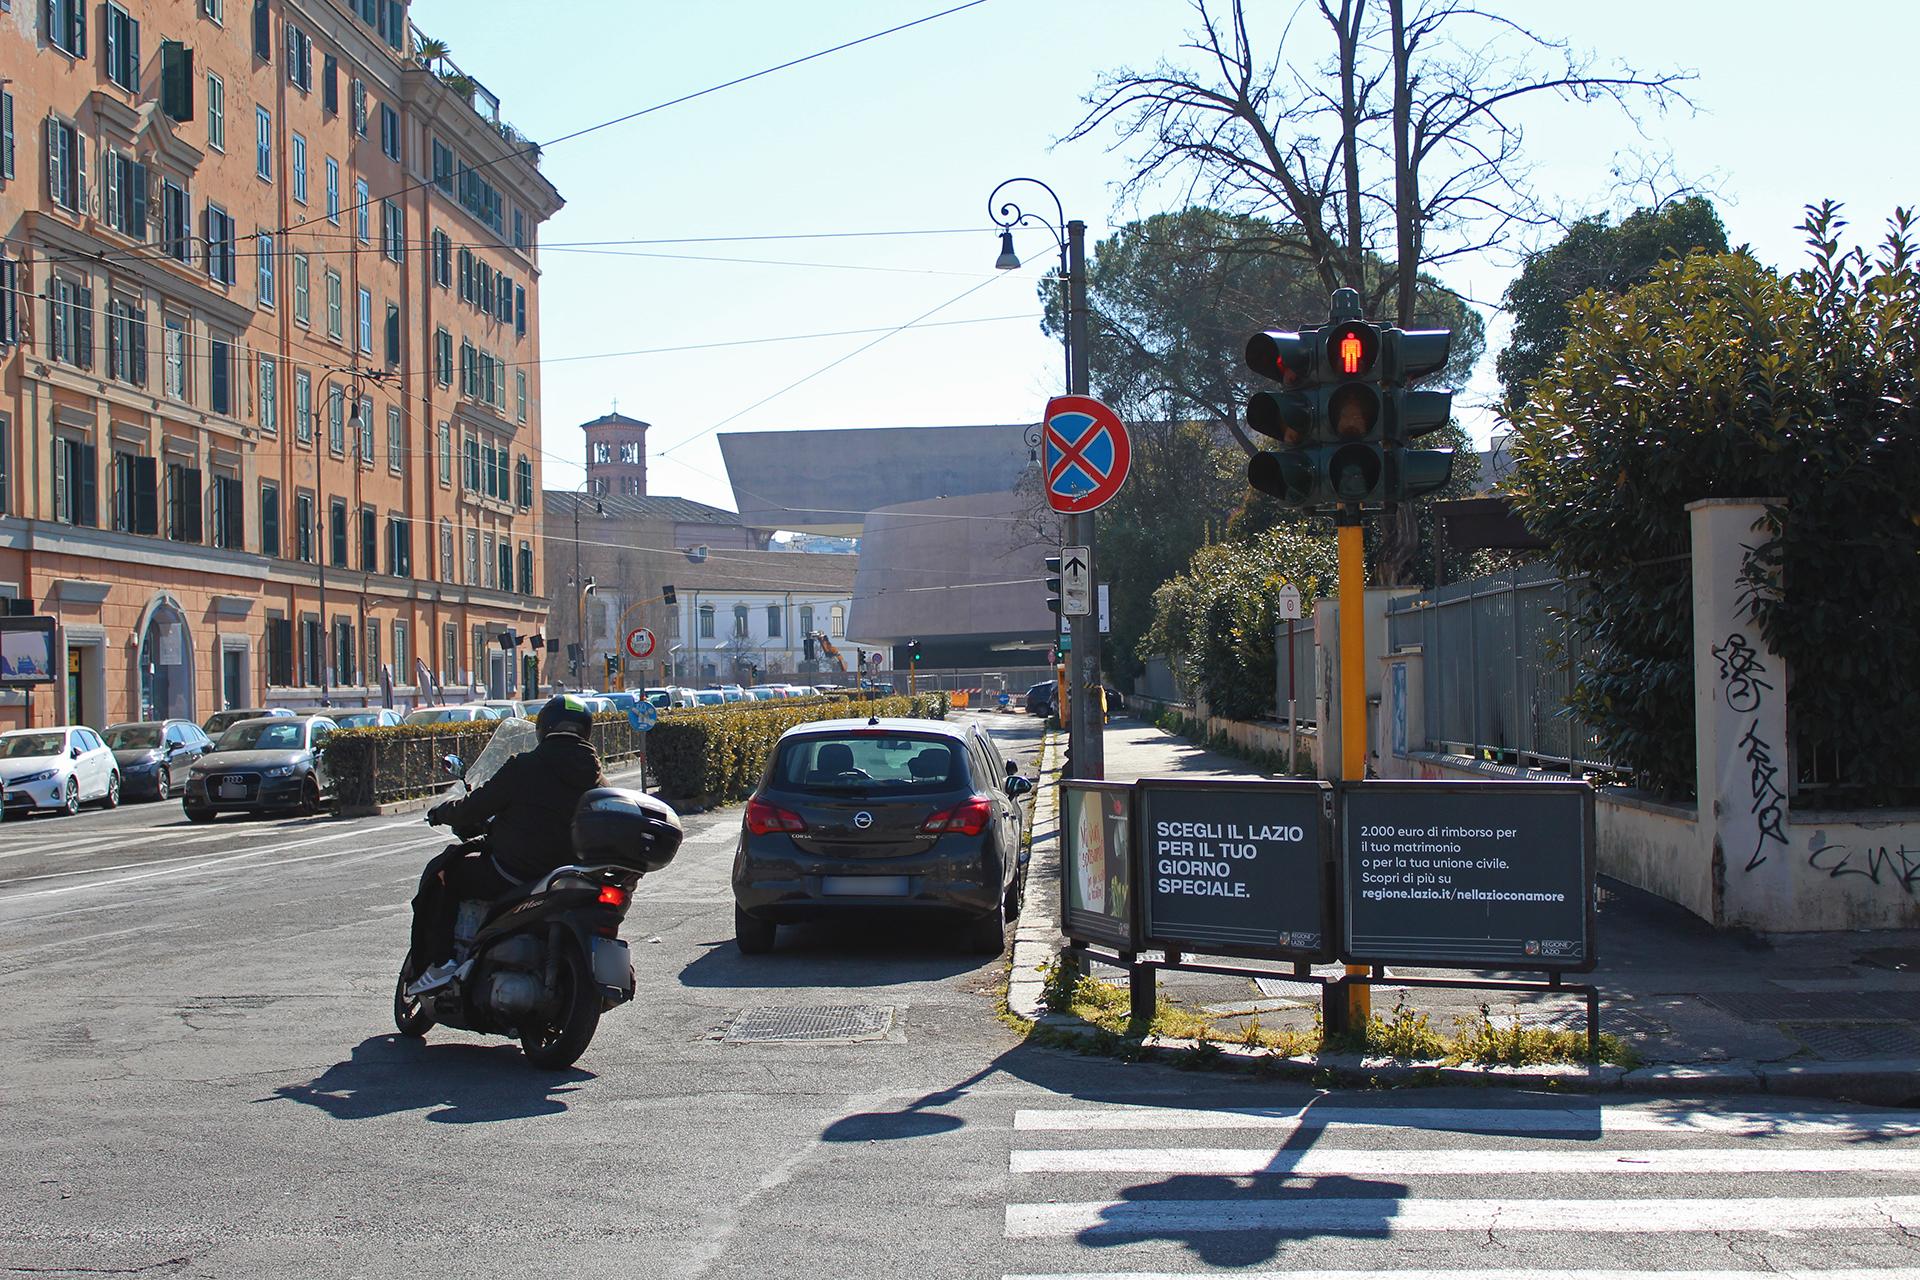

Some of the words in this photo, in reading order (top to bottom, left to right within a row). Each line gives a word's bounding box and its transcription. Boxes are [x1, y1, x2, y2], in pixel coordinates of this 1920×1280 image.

[1157, 822, 1221, 838] SCEGLI
[1228, 825, 1243, 839] IL
[1249, 825, 1303, 841] LAZIO
[1361, 826, 1394, 836] 2.000
[1427, 827, 1438, 836] di
[1442, 827, 1493, 837] rimborso
[1497, 830, 1516, 840] per
[1158, 841, 1193, 856] PER
[1199, 843, 1214, 857] IL
[1219, 843, 1257, 859] TUO
[1362, 841, 1367, 851] il
[1371, 843, 1390, 851] tuo
[1394, 842, 1461, 852] matrimonio
[1159, 860, 1230, 877] GIORNO
[1362, 859, 1369, 867] o
[1373, 860, 1392, 869] per
[1396, 857, 1406, 867] la
[1410, 858, 1429, 867] tua
[1433, 858, 1473, 868] unione
[1476, 858, 1509, 869] civile.
[1363, 872, 1399, 885] Scopri
[1403, 873, 1413, 883] di
[1417, 873, 1435, 885] più
[1159, 879, 1250, 898] SPECIALE.
[1363, 888, 1564, 901] regione.lazio.it/nellazioconamore
[1542, 940, 1568, 948] REGIONE
